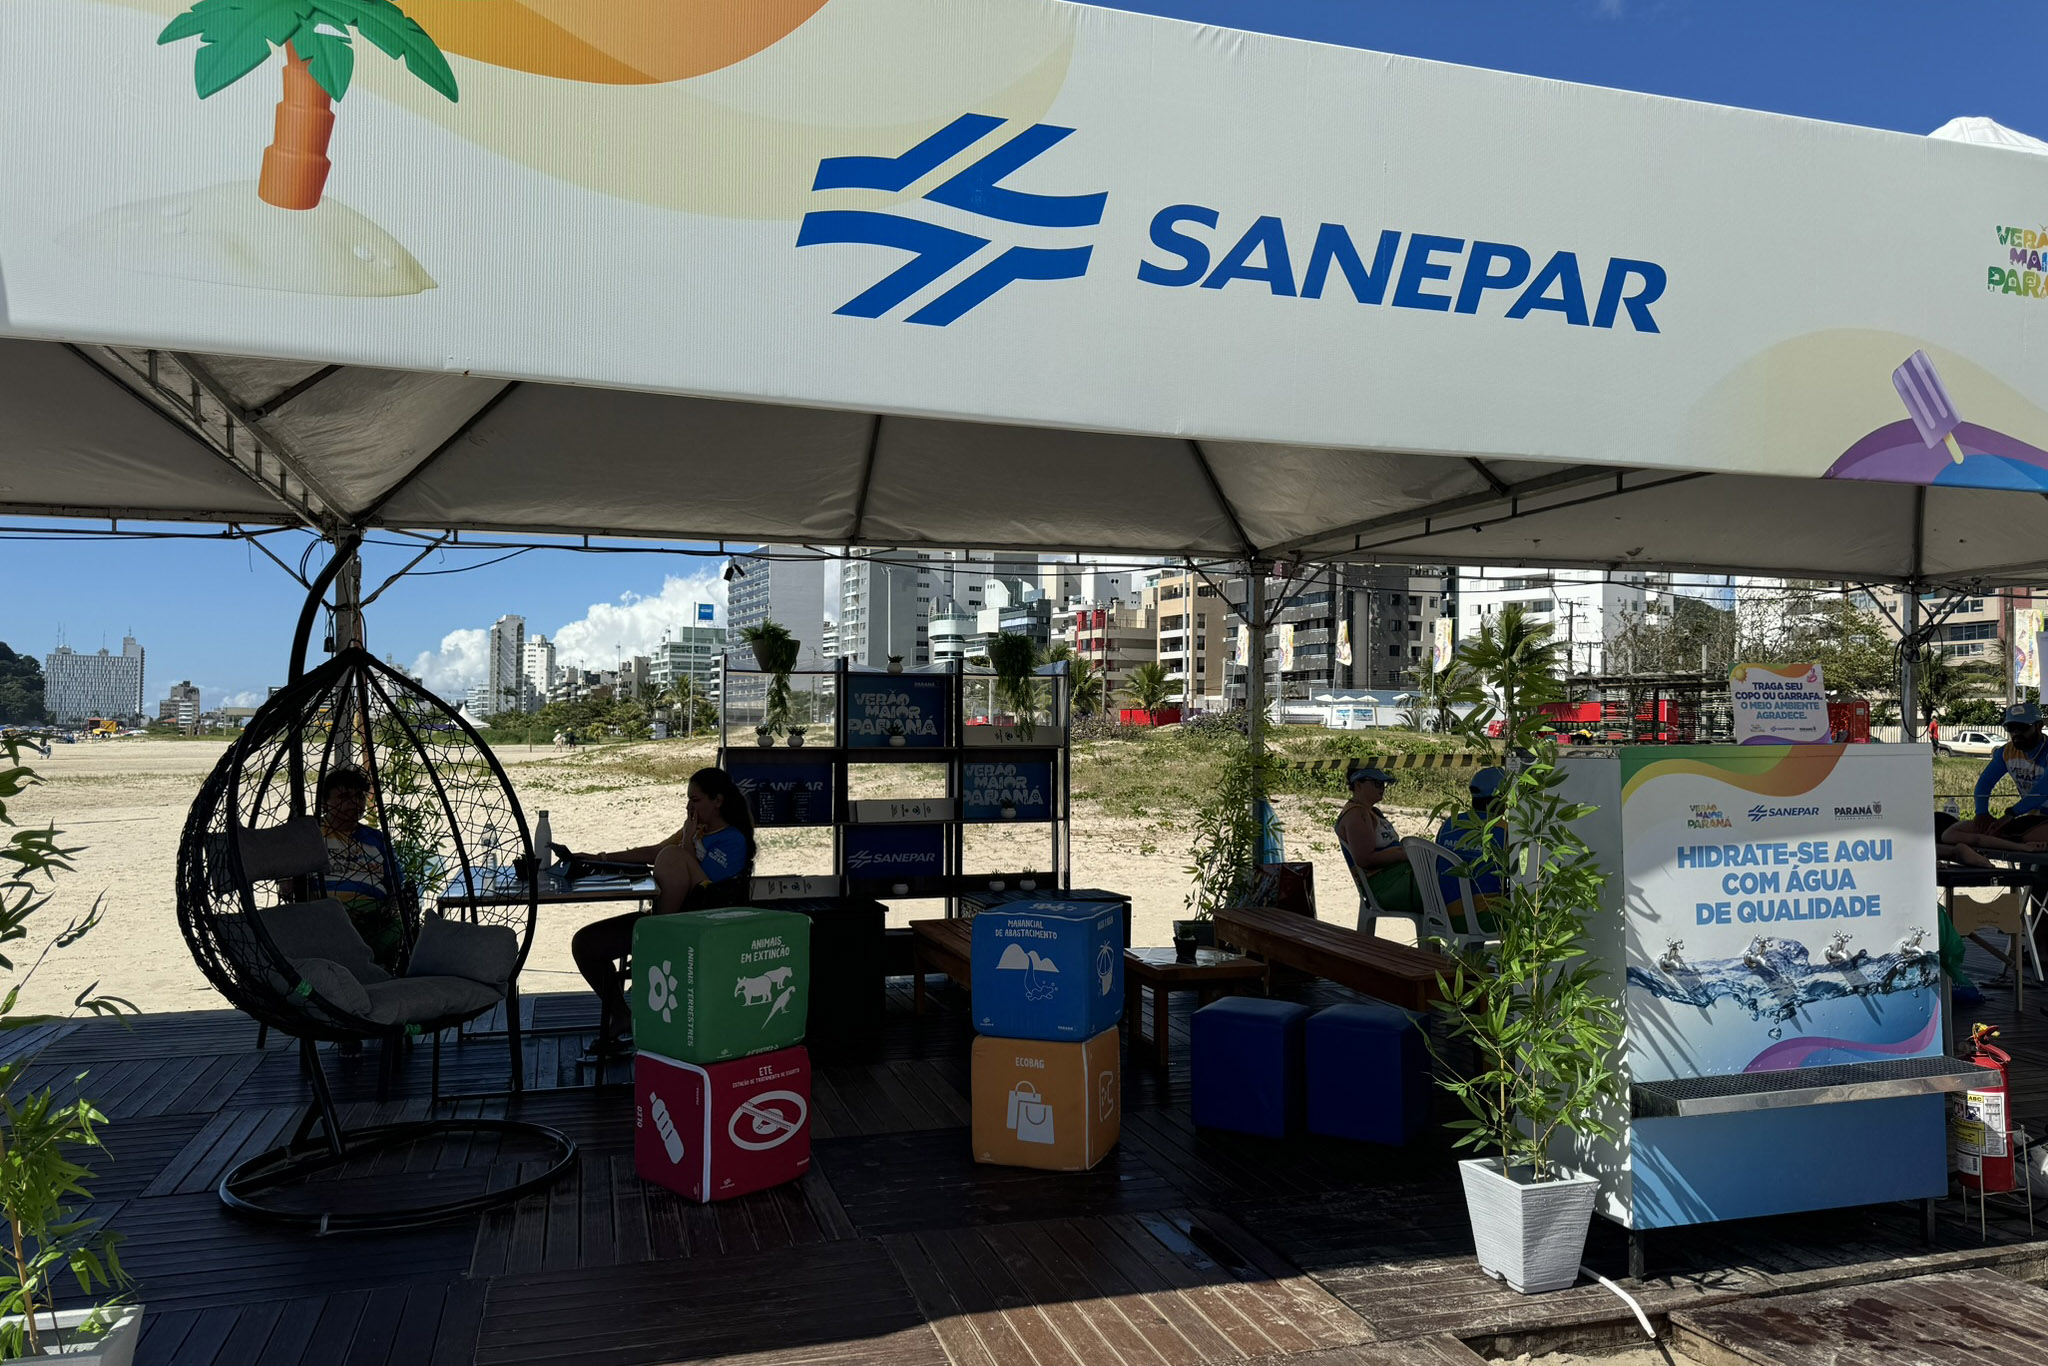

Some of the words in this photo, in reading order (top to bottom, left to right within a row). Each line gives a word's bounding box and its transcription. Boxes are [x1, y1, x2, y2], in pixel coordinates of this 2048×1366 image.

[1137, 203, 1668, 334] SANEPAR
[1752, 682, 1784, 690] TRAGA
[1785, 682, 1803, 690] SEU
[854, 690, 910, 706] VERÃO
[1735, 691, 1760, 700] COPO
[1762, 692, 1776, 700] OU
[1777, 691, 1823, 700] GARRAFA.
[865, 705, 921, 719] MAIOR
[1740, 702, 1748, 710] O
[1750, 702, 1772, 710] MEIO
[1774, 702, 1819, 710] AMBIENTE
[1756, 711, 1807, 720] AGRADECE.
[974, 776, 1028, 790] MAIOR
[1768, 806, 1820, 817] SANEPAR
[1834, 804, 1873, 816] PARANÁ
[1688, 816, 1733, 829] PARANÁ
[872, 852, 936, 863] SANEPAR
[1677, 841, 1829, 868] HIDRATE-SE
[1834, 839, 1893, 863] AQUI
[1721, 871, 1780, 895] COM
[1785, 864, 1856, 893] ÁGUA
[1696, 902, 1732, 925] DE
[1737, 894, 1881, 923] QUALIDADE
[995, 928, 1003, 937] DE
[751, 936, 782, 950] ANIMAIS
[741, 952, 752, 964] EM
[753, 943, 790, 962] EXTINÇÃO
[687, 946, 695, 985] ANIMAIS
[687, 986, 695, 1047] TERRESTRES
[1015, 1056, 1045, 1069] ECOBAG
[758, 1065, 773, 1077] ETE
